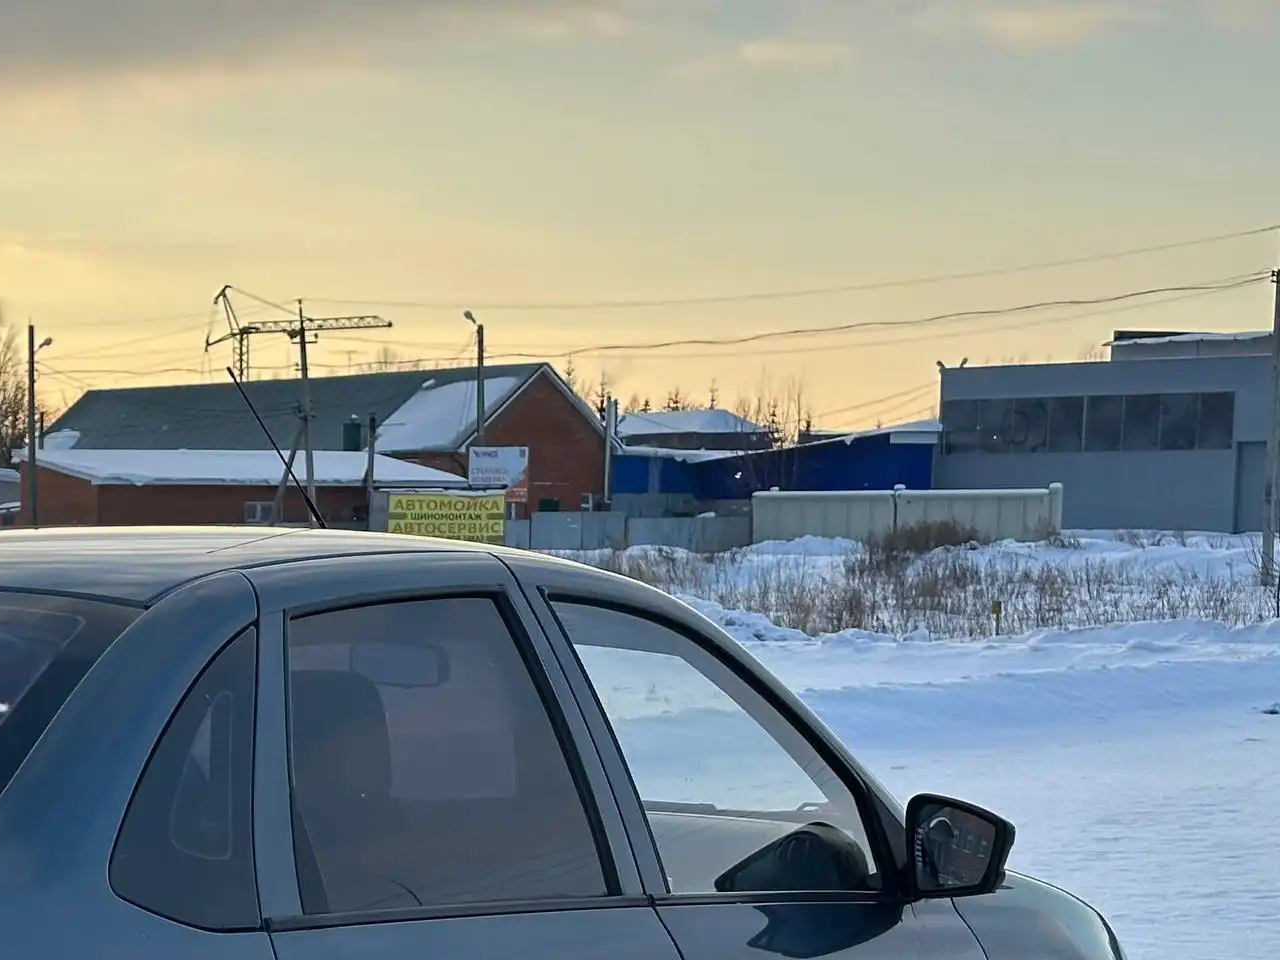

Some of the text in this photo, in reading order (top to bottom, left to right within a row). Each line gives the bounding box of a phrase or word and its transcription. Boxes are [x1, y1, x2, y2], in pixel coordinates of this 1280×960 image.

[393, 498, 500, 511] АВТОМОЙКА
[411, 512, 482, 520] ШИНОМОНТАЖ
[393, 523, 500, 534] АВТОСЕРВИС
